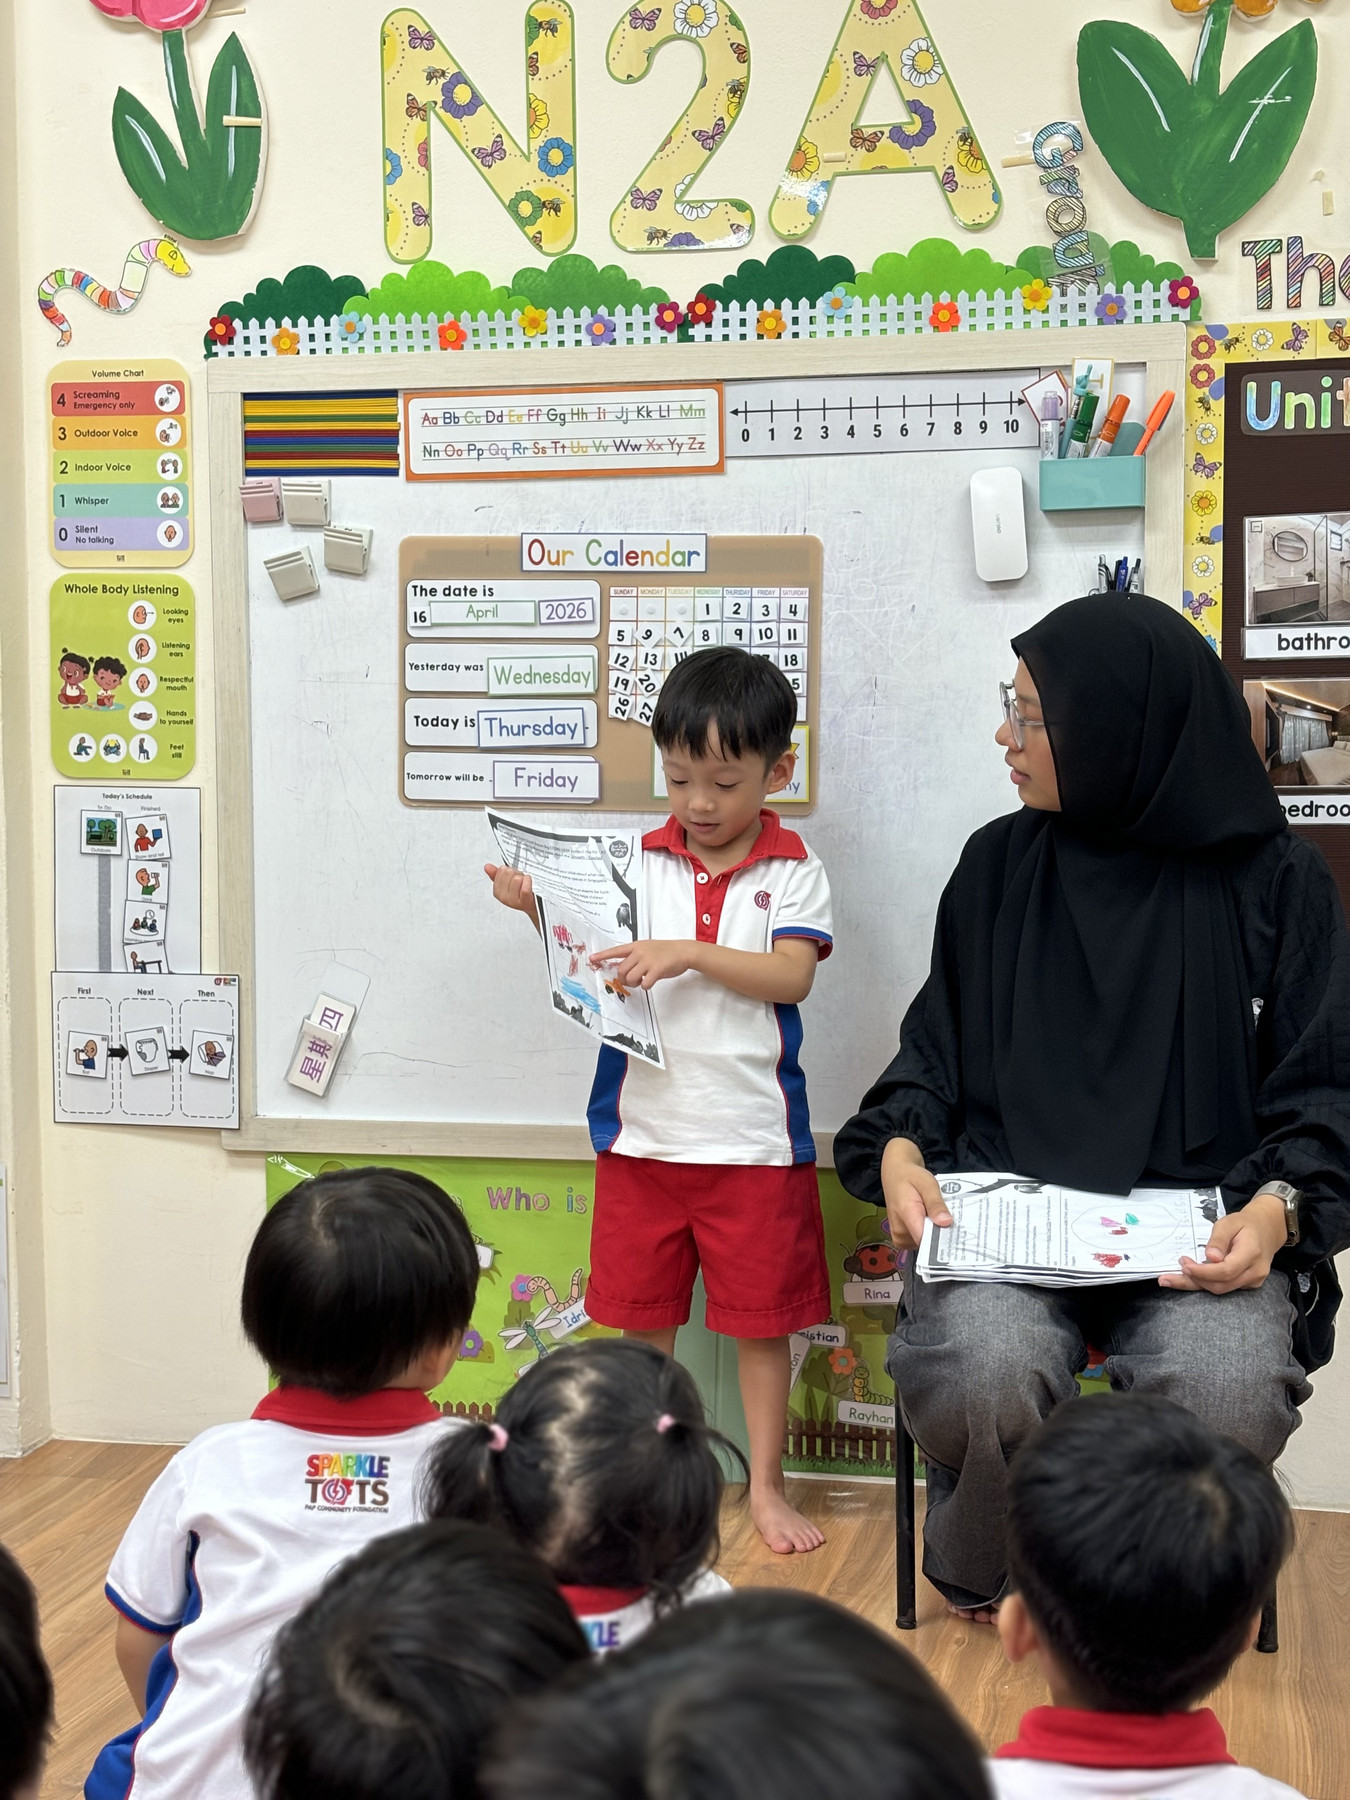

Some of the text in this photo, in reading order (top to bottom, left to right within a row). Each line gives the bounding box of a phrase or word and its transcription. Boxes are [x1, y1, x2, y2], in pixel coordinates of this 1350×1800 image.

[379, 0, 1002, 263] N2A
[91, 369, 144, 378] Volume Chart
[56, 390, 120, 407] 4 Screaming
[73, 401, 135, 411] Emergency only
[422, 403, 705, 426] Aa Bb Cc Dd Ee Ff Gg Hh Ii Jj Kk Ll Mm
[58, 427, 138, 441] 3 Outdoor Voice
[741, 419, 1020, 443] 0 1 2 3 4 5 6 7 8 9 10
[423, 437, 705, 461] Nn Oo Pp Qq Rr Ss Tt Uu Vv Ww Xx Yy Zz
[59, 461, 132, 475] 2 Indoor Voice
[59, 494, 109, 508] 1 Whisper
[58, 525, 98, 542] 0 Silent
[75, 535, 114, 545] No talking
[527, 538, 701, 568] Our Calendar
[64, 583, 179, 597] Whole Body Listening
[411, 584, 495, 598] The date is
[668, 588, 692, 596] TUESDAY
[162, 608, 189, 617] Looking
[413, 602, 587, 624] 16 April 2026
[705, 603, 798, 617] 1 2 3 4
[168, 616, 184, 625] eyes
[616, 629, 625, 642] 5
[673, 626, 684, 639] 7
[701, 629, 710, 642] 8
[734, 628, 743, 641] 9
[758, 627, 774, 641] 10
[787, 628, 797, 641] 11
[161, 642, 191, 651] Listening
[1278, 632, 1350, 651] bathro
[169, 650, 184, 658] ears
[614, 653, 630, 669] 12
[644, 652, 657, 666] 13
[784, 654, 798, 667] 18
[159, 675, 194, 685] Respectful
[408, 662, 591, 690] Yesterday was Wednesday
[166, 683, 188, 692] mouth
[614, 676, 630, 691] 19
[638, 674, 656, 693] 20
[166, 709, 187, 718] Hands
[615, 697, 653, 722] 26 27
[159, 718, 194, 727] to yourself
[414, 715, 578, 740] Today is Thursday
[169, 743, 185, 751] Feet
[171, 751, 183, 759] still
[406, 767, 578, 793] Tomorrow will be Friday
[77, 987, 91, 995] First
[137, 988, 154, 996] Next
[487, 1186, 587, 1214] Who is
[864, 1287, 890, 1300] Rina
[849, 1408, 894, 1425] Rayhan
[306, 1454, 390, 1478] SPARKLE
